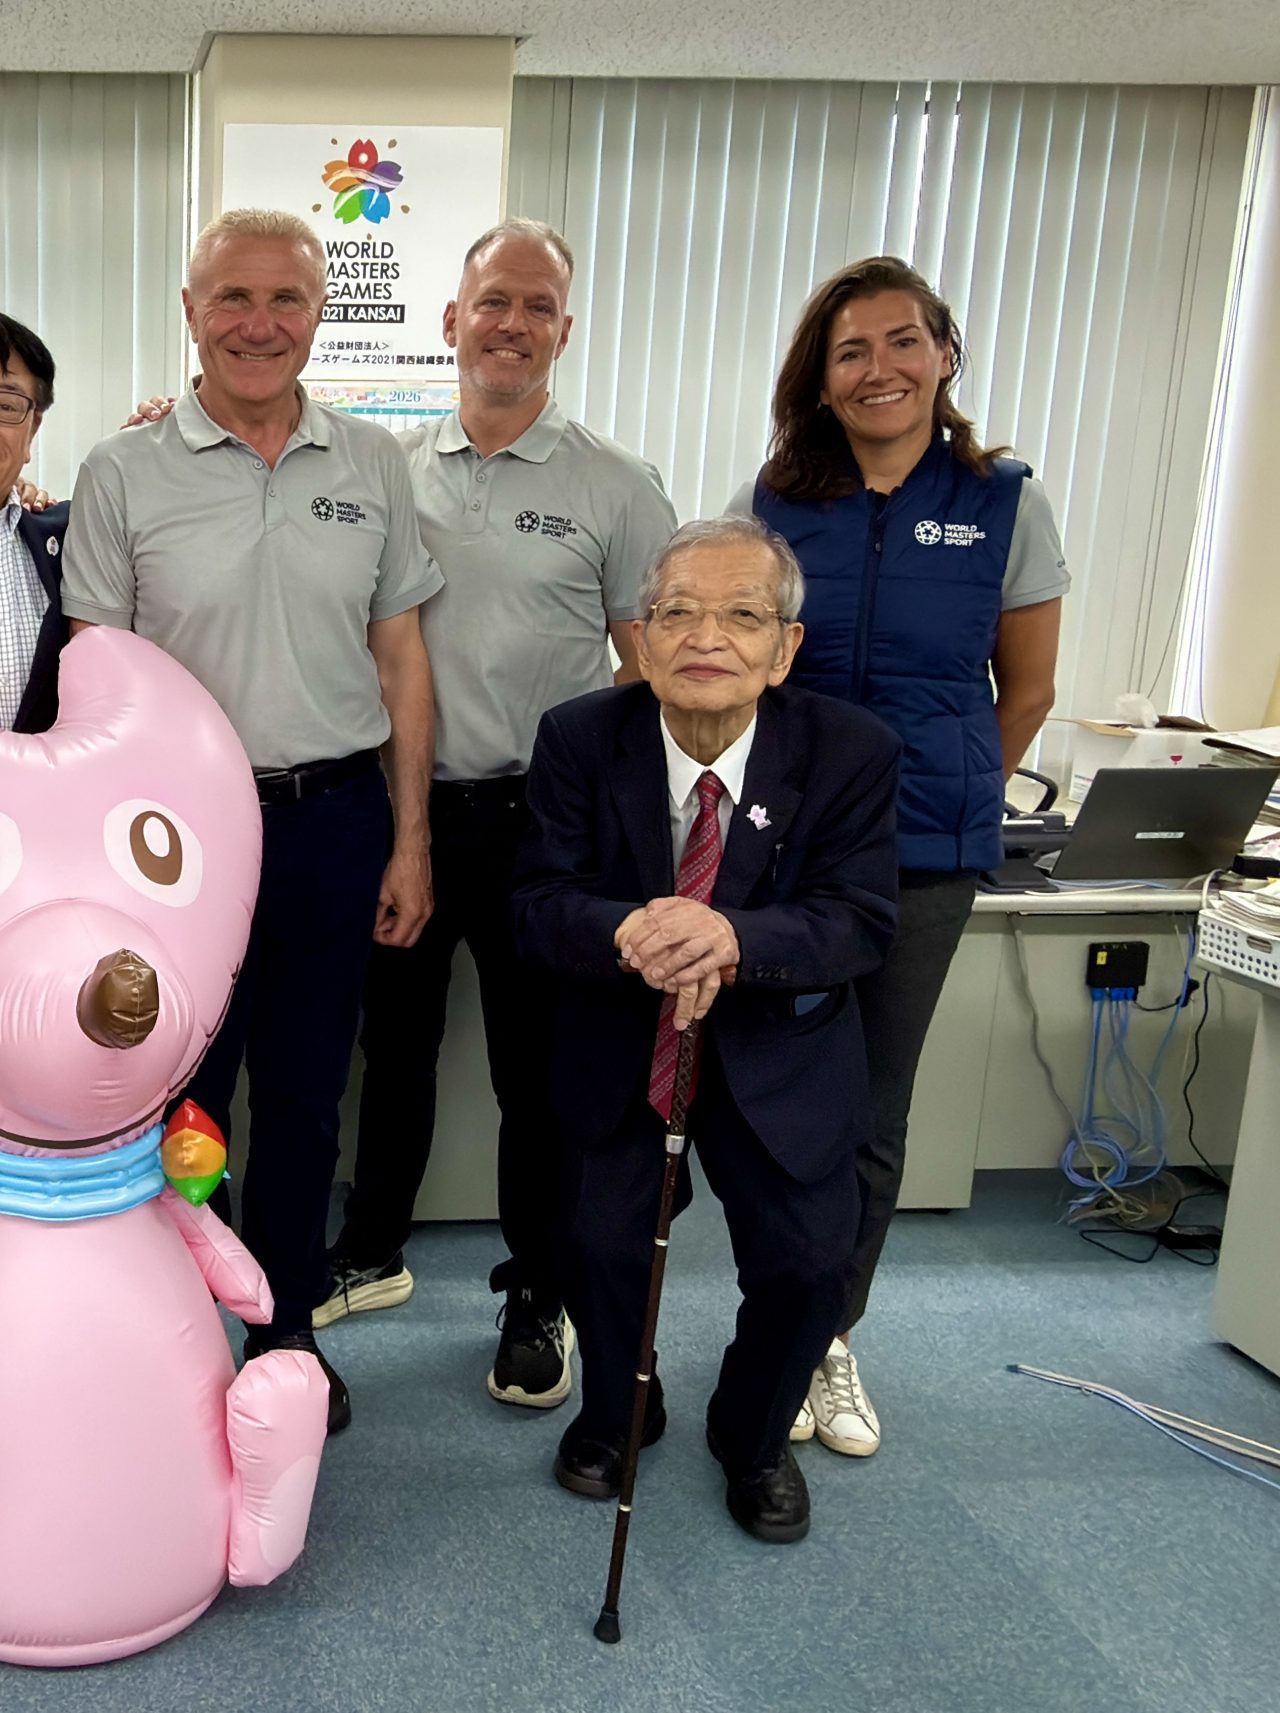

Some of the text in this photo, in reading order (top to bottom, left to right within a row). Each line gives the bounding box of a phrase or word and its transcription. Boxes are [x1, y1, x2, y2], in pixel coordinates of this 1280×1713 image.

[326, 241, 394, 259] WORLD
[326, 281, 393, 300] GAMES
[322, 305, 401, 321] 021 KANSAI
[389, 391, 421, 403] 2026
[336, 501, 361, 511] WORLD
[336, 509, 367, 520] MASTERS
[336, 515, 359, 525] SPORT
[543, 514, 572, 526] WORLD
[542, 521, 577, 535] MASTERS
[944, 523, 977, 531] WORLD
[541, 528, 566, 539] SPORT
[944, 531, 987, 539] MASTERS
[944, 538, 974, 546] SPORT
